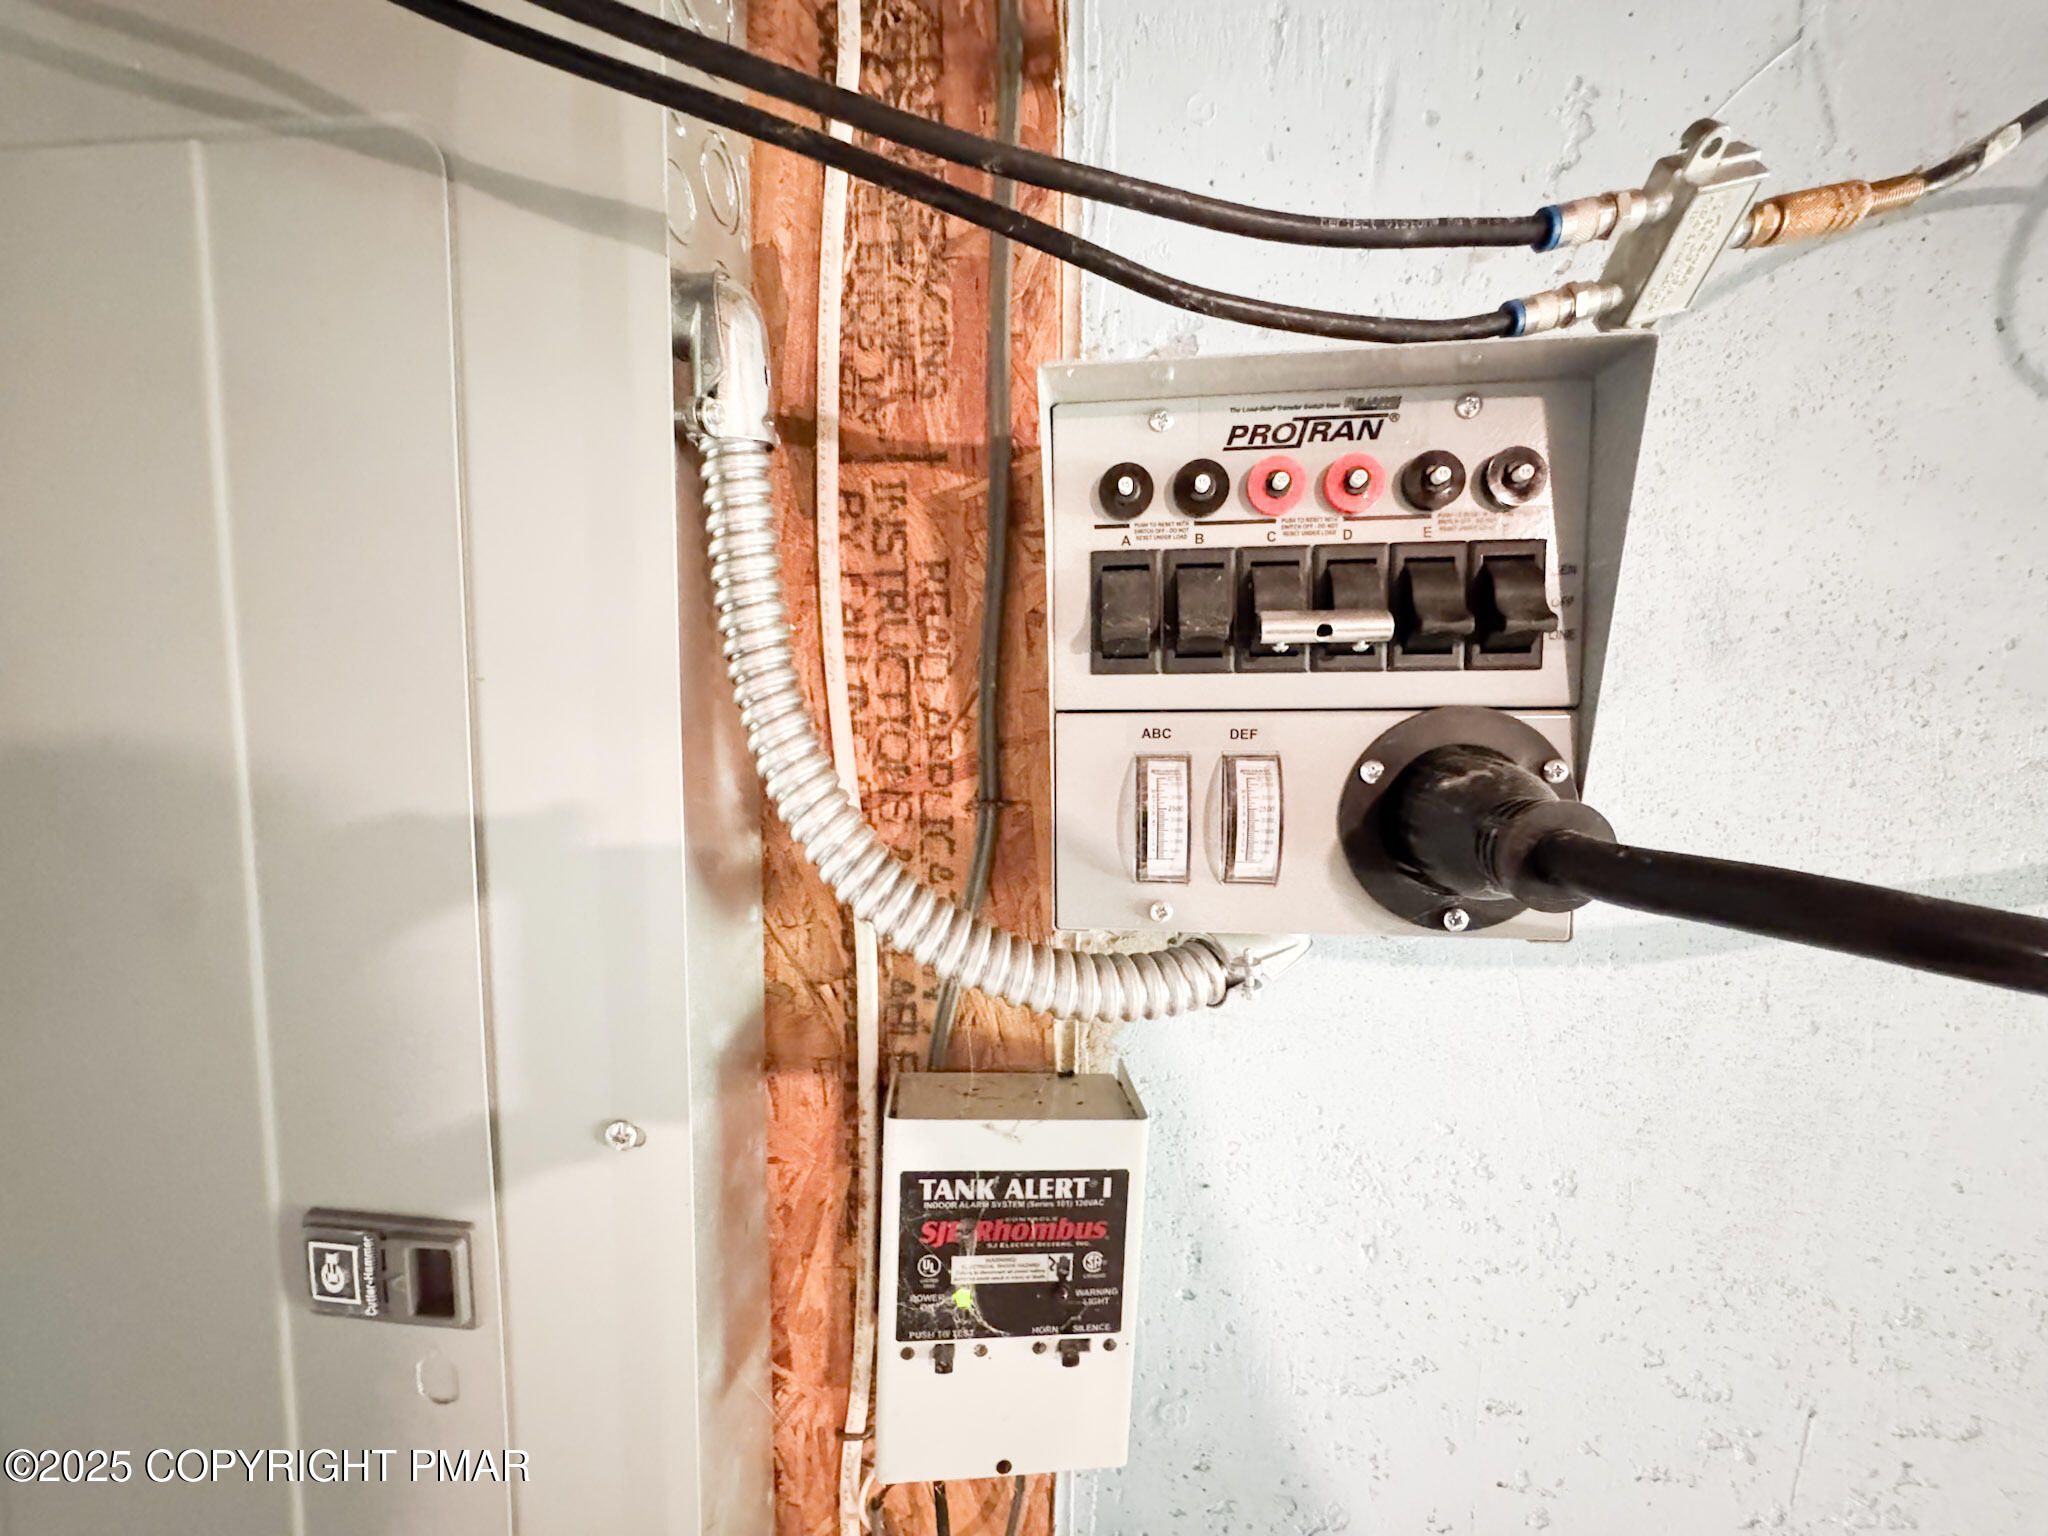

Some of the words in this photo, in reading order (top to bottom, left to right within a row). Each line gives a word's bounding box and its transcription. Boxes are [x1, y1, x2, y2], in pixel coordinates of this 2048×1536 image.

[1223, 413, 1389, 450] PROTRAN
[1266, 530, 1277, 543] C
[1342, 529, 1353, 541] D
[1423, 526, 1433, 539] E
[1121, 534, 1132, 547] A
[1194, 533, 1205, 545] B
[1141, 727, 1172, 740] ABC
[1229, 728, 1258, 740] DEF
[918, 1178, 996, 1201] TANK
[1004, 1177, 1090, 1200] ALERT
[1102, 1176, 1112, 1199] I
[923, 1201, 958, 1210] INDOOR
[958, 1200, 990, 1209] ALARM
[991, 1200, 1025, 1209] SYSTEM
[1075, 1287, 1119, 1297] WARNING
[1082, 1296, 1111, 1306] LIGHT
[1031, 1325, 1060, 1335] HORN
[1072, 1323, 1112, 1333] SILENCE
[908, 1330, 935, 1339] PUSH
